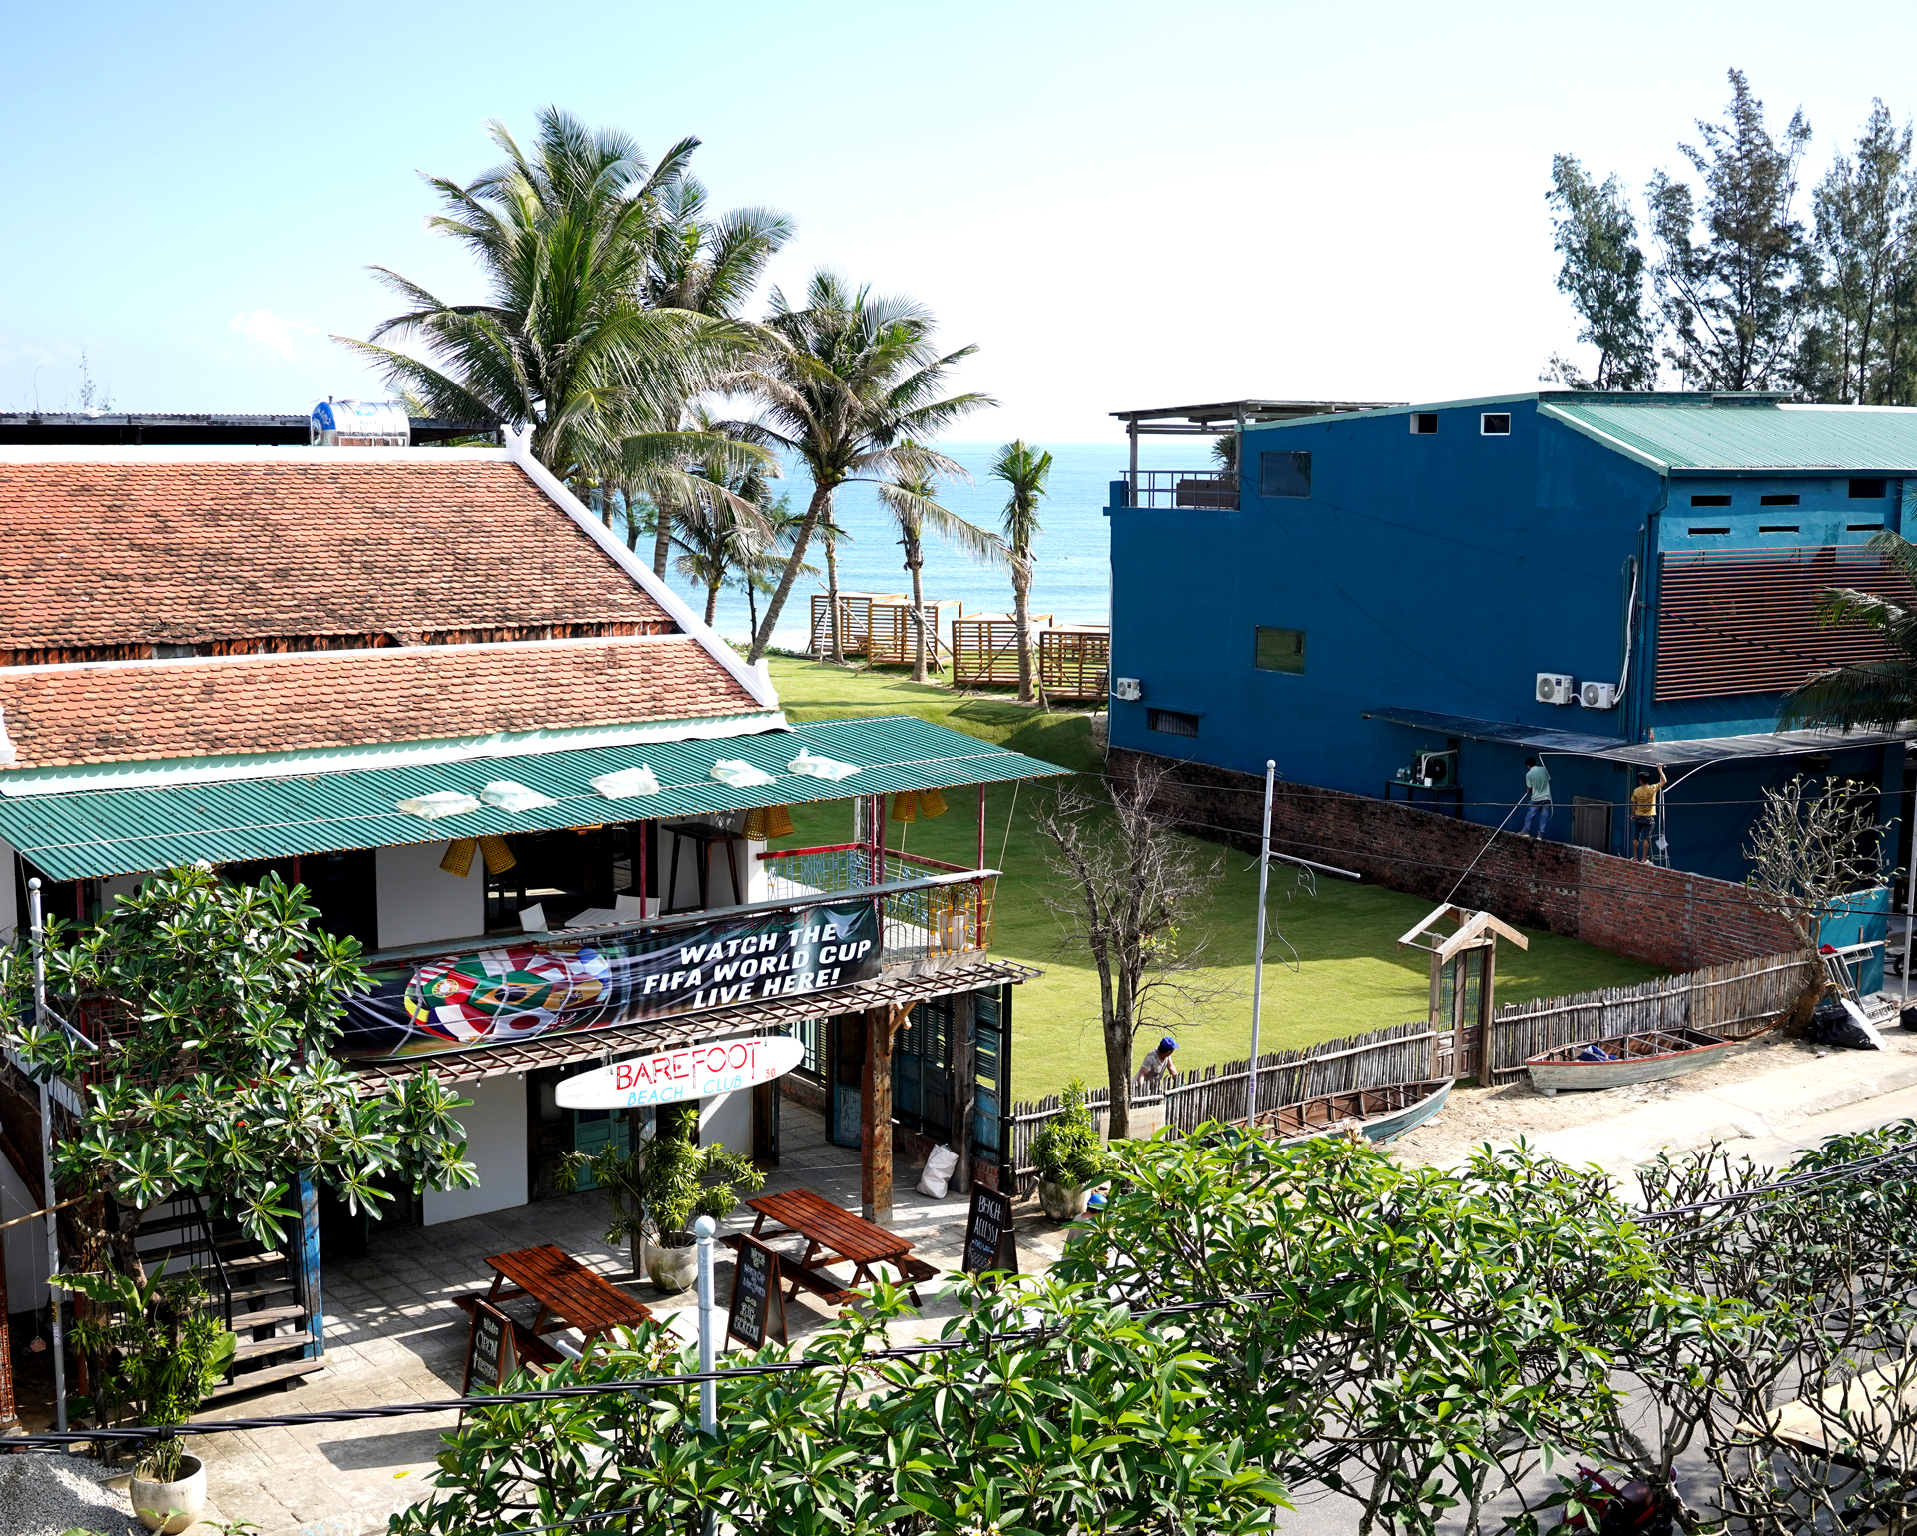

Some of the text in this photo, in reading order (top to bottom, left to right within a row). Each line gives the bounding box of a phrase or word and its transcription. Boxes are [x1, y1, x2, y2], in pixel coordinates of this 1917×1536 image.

[680, 923, 838, 965] WATCH THE
[643, 939, 872, 995] FIFA WORLD CUP
[692, 967, 841, 1010] LIVE HERE!
[616, 1041, 761, 1090] BAREFOOT
[765, 1068, 777, 1079] 30
[627, 1075, 742, 1106] BEACH CLUB
[978, 1195, 1002, 1221] BEACH
[973, 1216, 999, 1245] ACCESS!
[475, 1329, 499, 1361] OPEN
